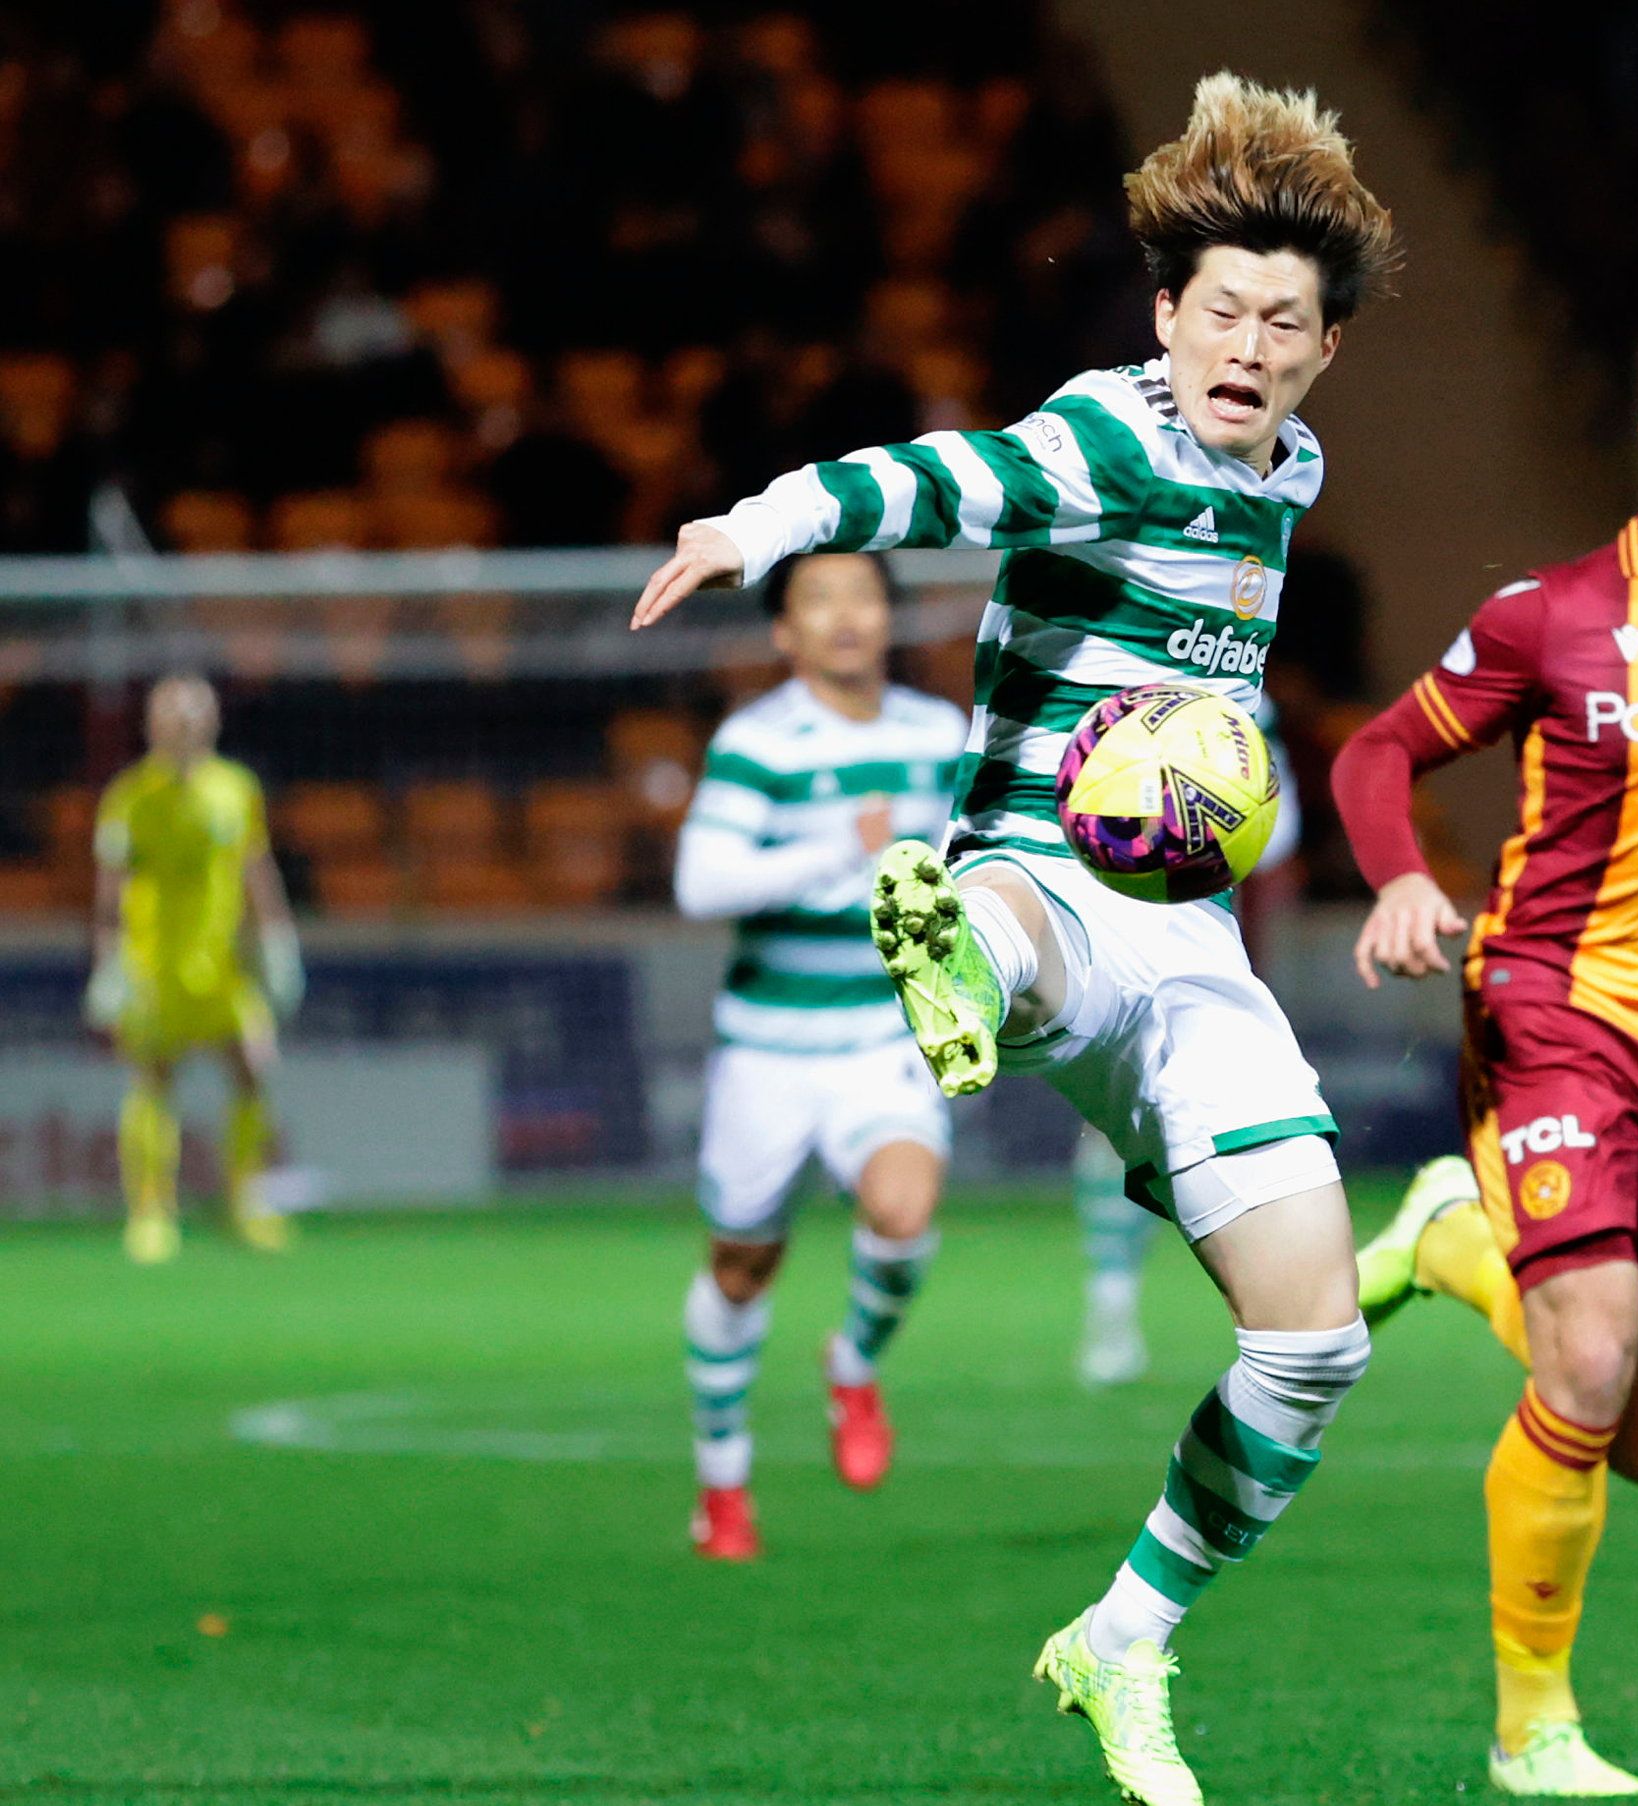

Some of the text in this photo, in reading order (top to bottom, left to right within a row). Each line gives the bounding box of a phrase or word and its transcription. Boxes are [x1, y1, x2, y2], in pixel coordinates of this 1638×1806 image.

[1183, 525, 1219, 543] adidas
[1166, 618, 1270, 676] dafabe
[1501, 1114, 1597, 1164] TCL
